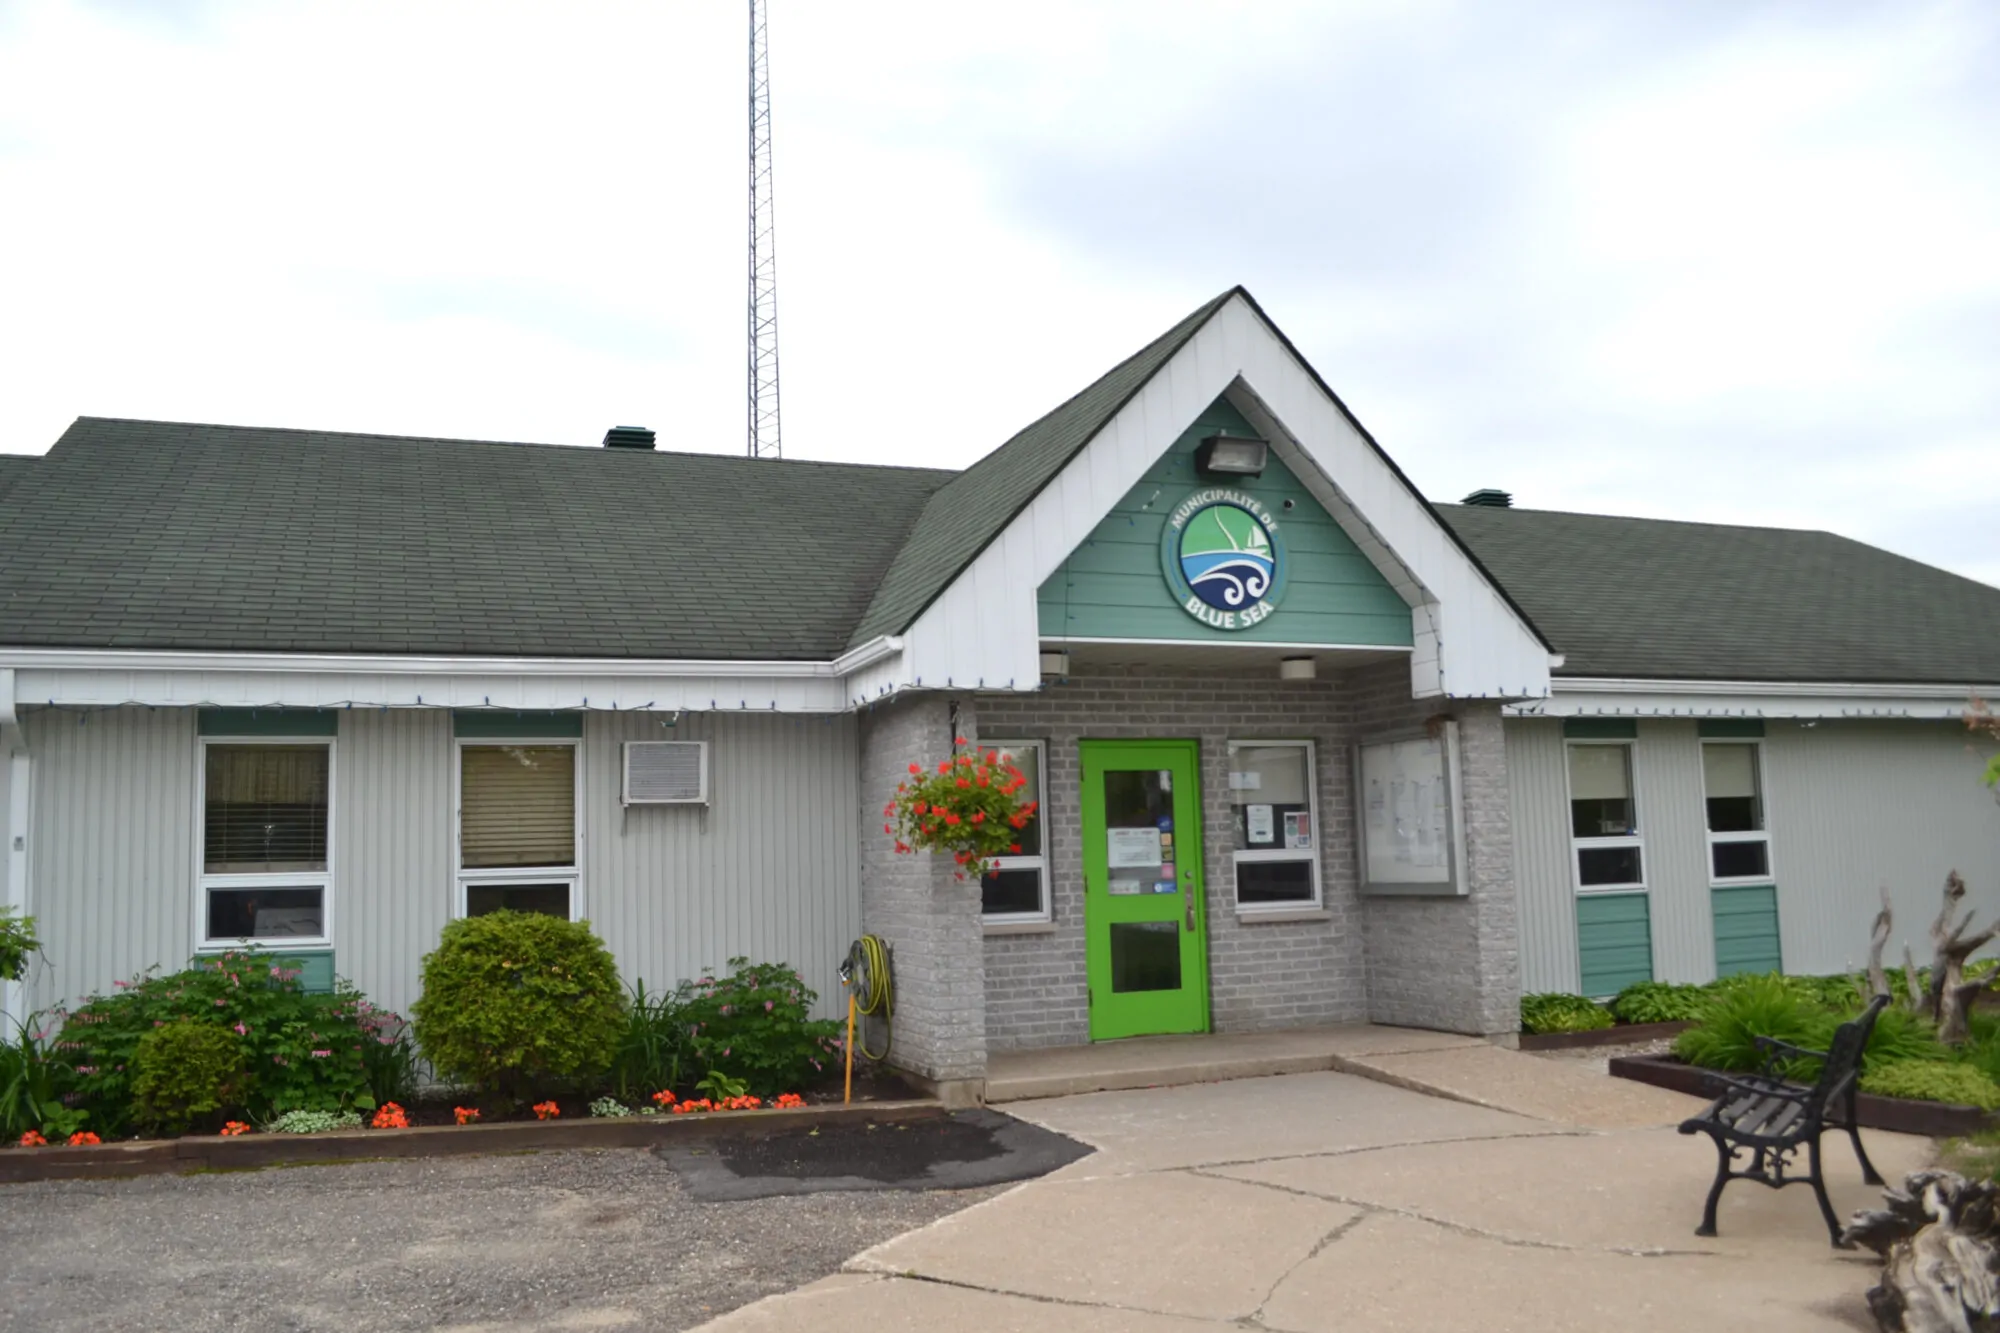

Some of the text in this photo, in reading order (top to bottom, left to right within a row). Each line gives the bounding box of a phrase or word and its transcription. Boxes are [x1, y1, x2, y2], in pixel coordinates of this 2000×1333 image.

[1171, 489, 1278, 532] MUNICIPALITÉ DE
[1185, 597, 1274, 628] BLUE SEA
